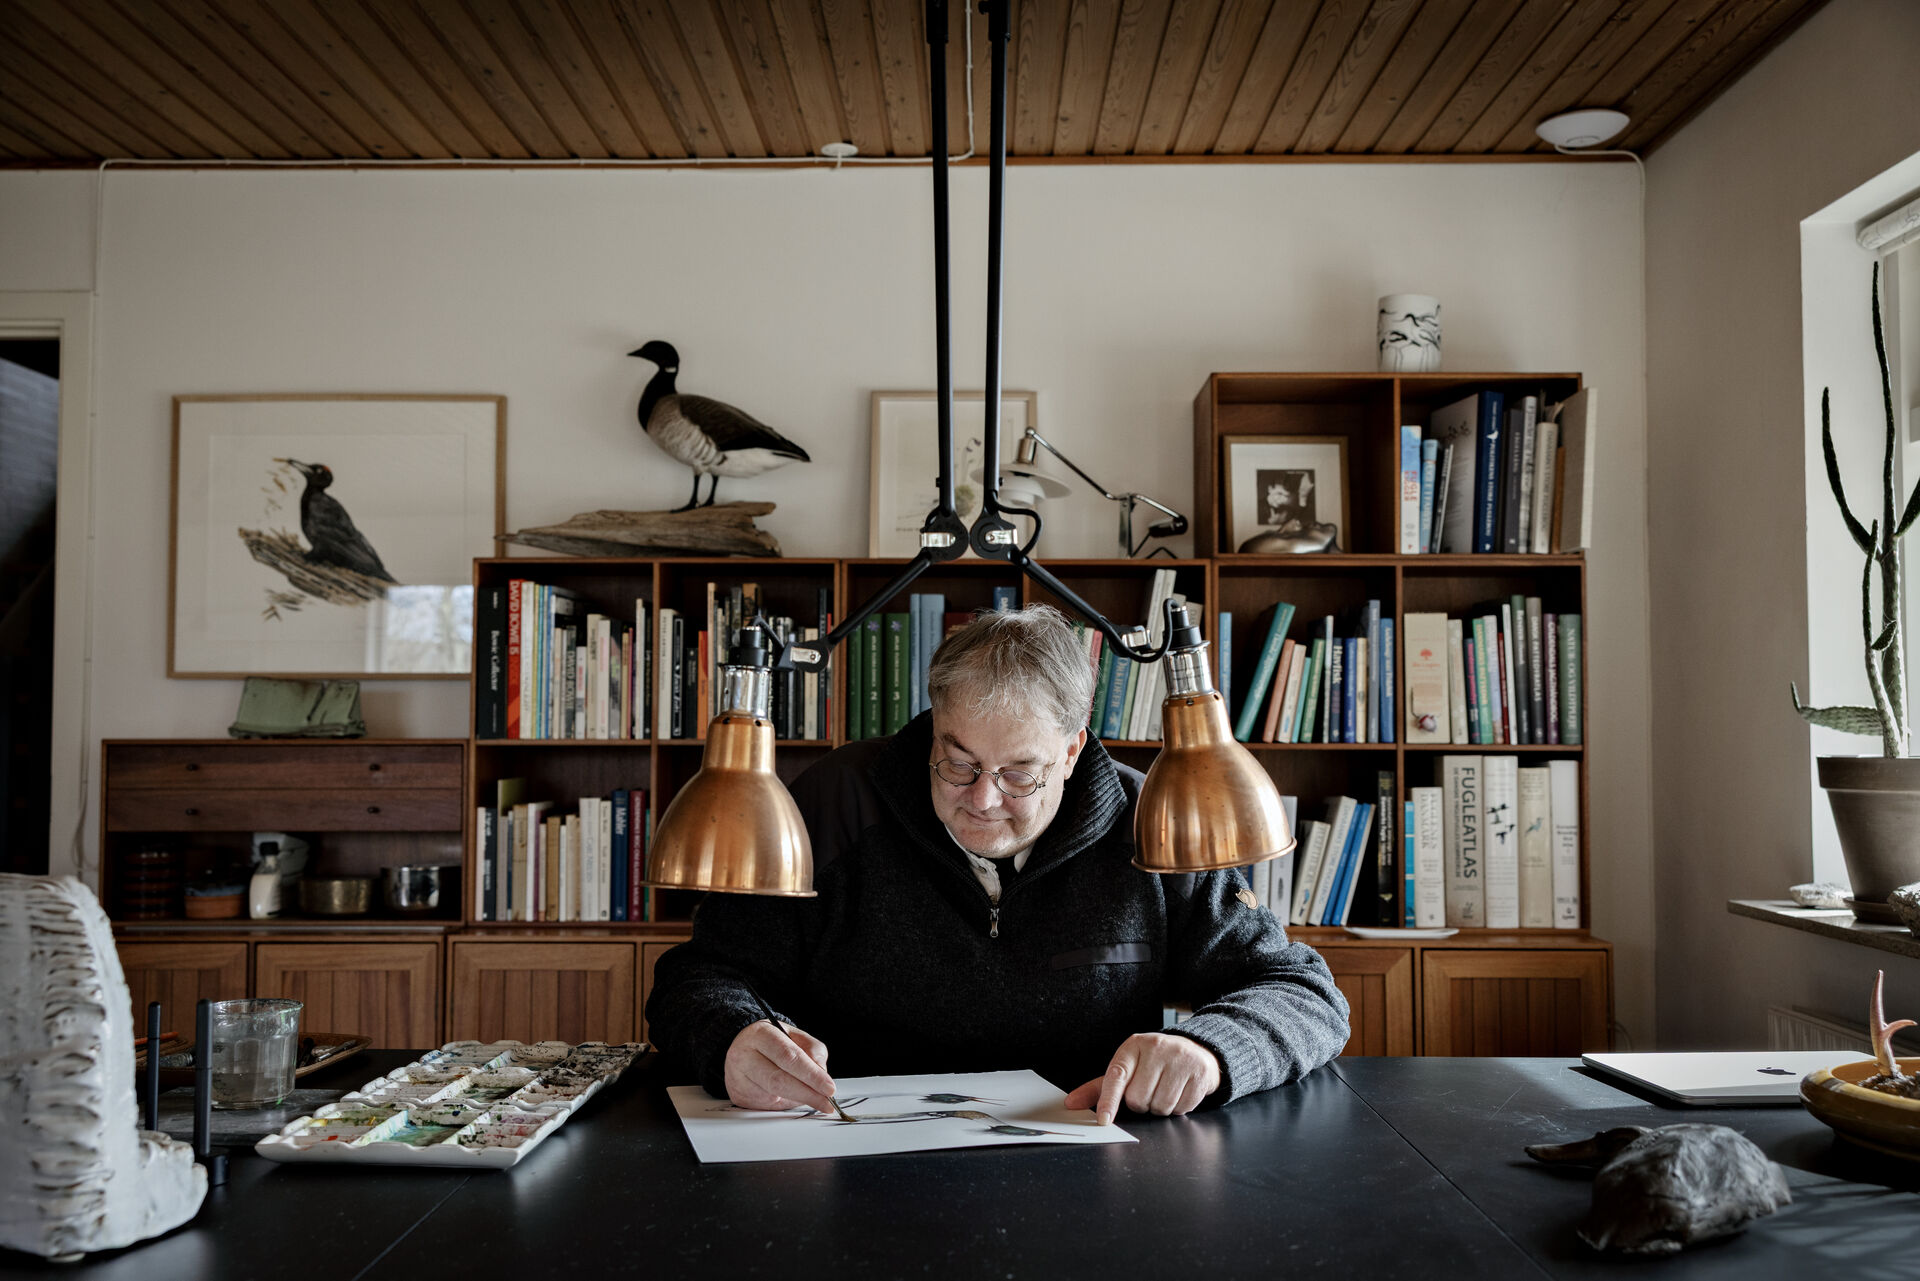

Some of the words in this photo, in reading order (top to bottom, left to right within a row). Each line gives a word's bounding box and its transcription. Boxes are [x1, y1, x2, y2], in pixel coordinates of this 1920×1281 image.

[1410, 470, 1418, 501] FUGLE
[509, 580, 520, 611] DAVID
[490, 630, 500, 654] Bowie
[509, 613, 520, 644] BOWIE
[1531, 616, 1539, 640] DANSK
[509, 646, 519, 656] IS
[566, 650, 576, 679] DAVID
[1332, 645, 1343, 684] Havfisk
[490, 655, 501, 691] Collector
[1567, 662, 1577, 678] OG
[566, 681, 576, 709] BOWIE
[615, 807, 626, 836] Mahler
[1461, 767, 1477, 878] FUGLEATLAS
